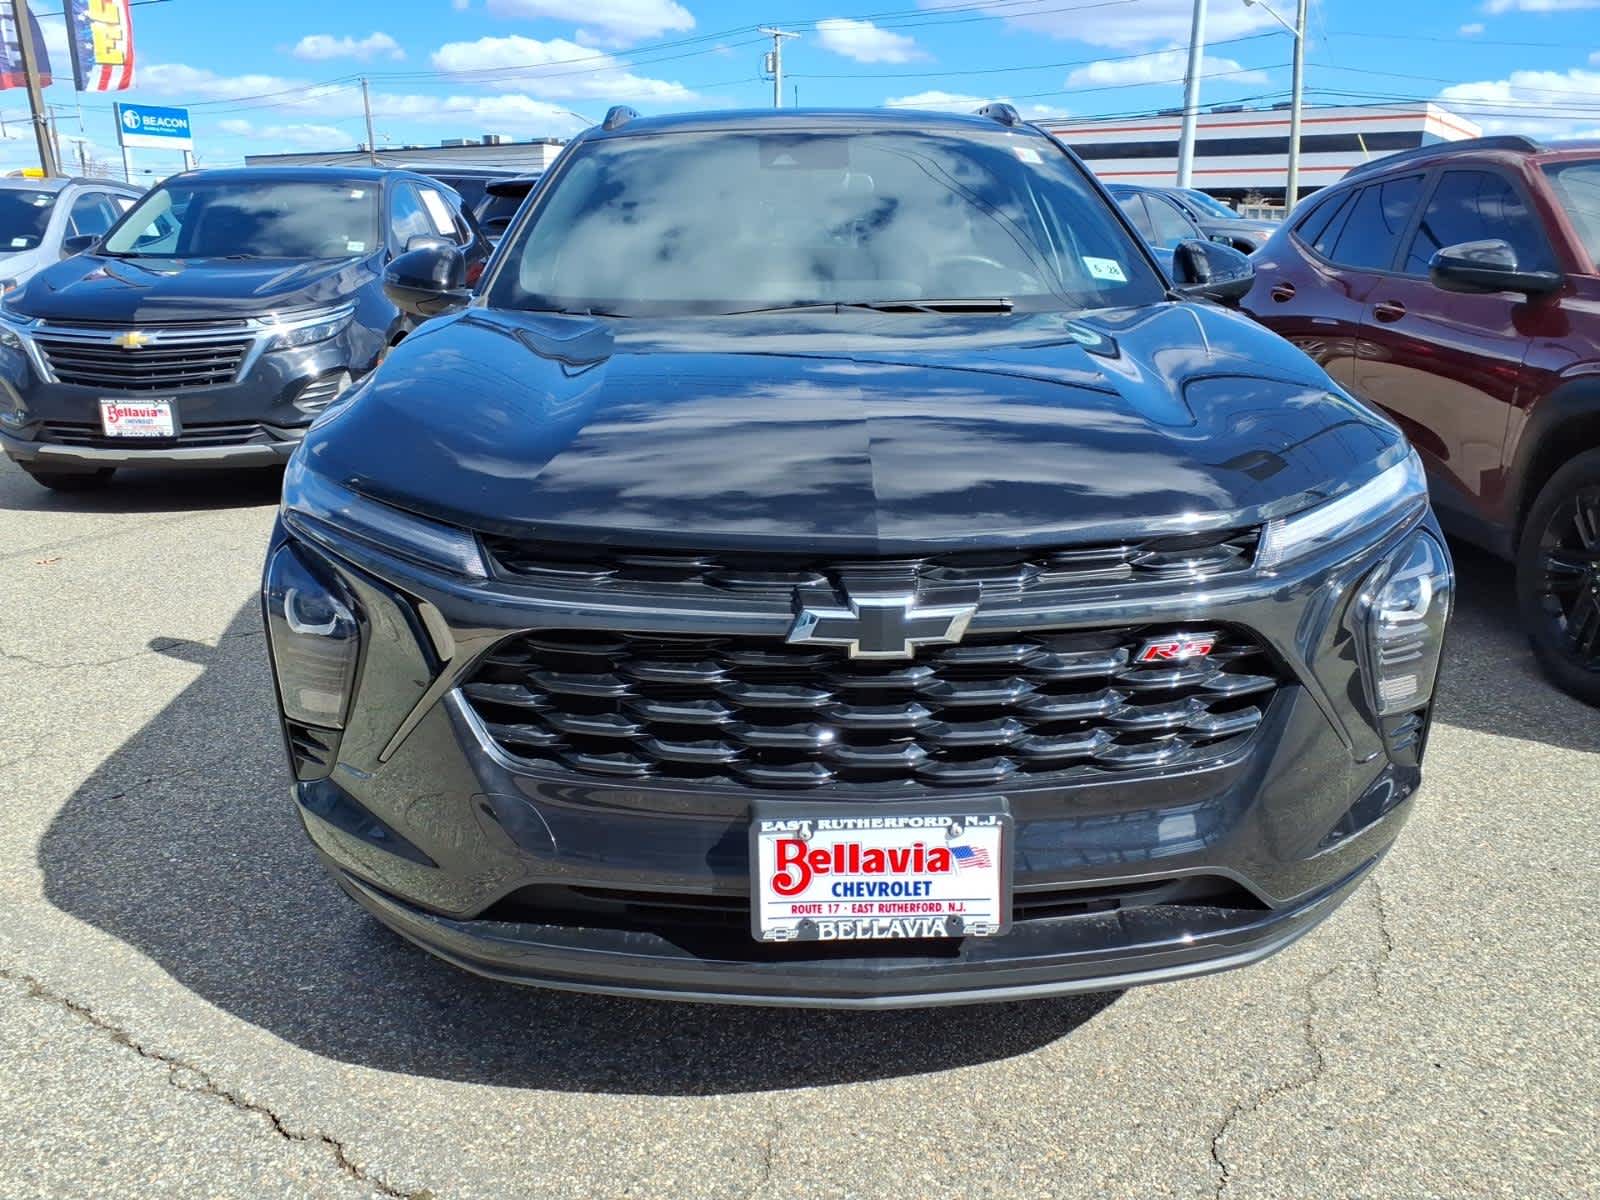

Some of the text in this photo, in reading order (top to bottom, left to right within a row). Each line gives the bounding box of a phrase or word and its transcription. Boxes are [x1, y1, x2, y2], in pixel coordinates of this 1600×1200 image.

[142, 115, 188, 129] BEACON
[107, 405, 158, 423] Bellavia
[1142, 639, 1215, 661] RS
[761, 820, 813, 832] EAST
[965, 815, 1003, 827] N.J.
[772, 839, 950, 896] Bellavia
[832, 881, 932, 897] CHEVROLET
[791, 902, 967, 914] ROUTE 17 EAST RUTHERFORD, N.J.
[818, 918, 948, 940] BELLAVIA
